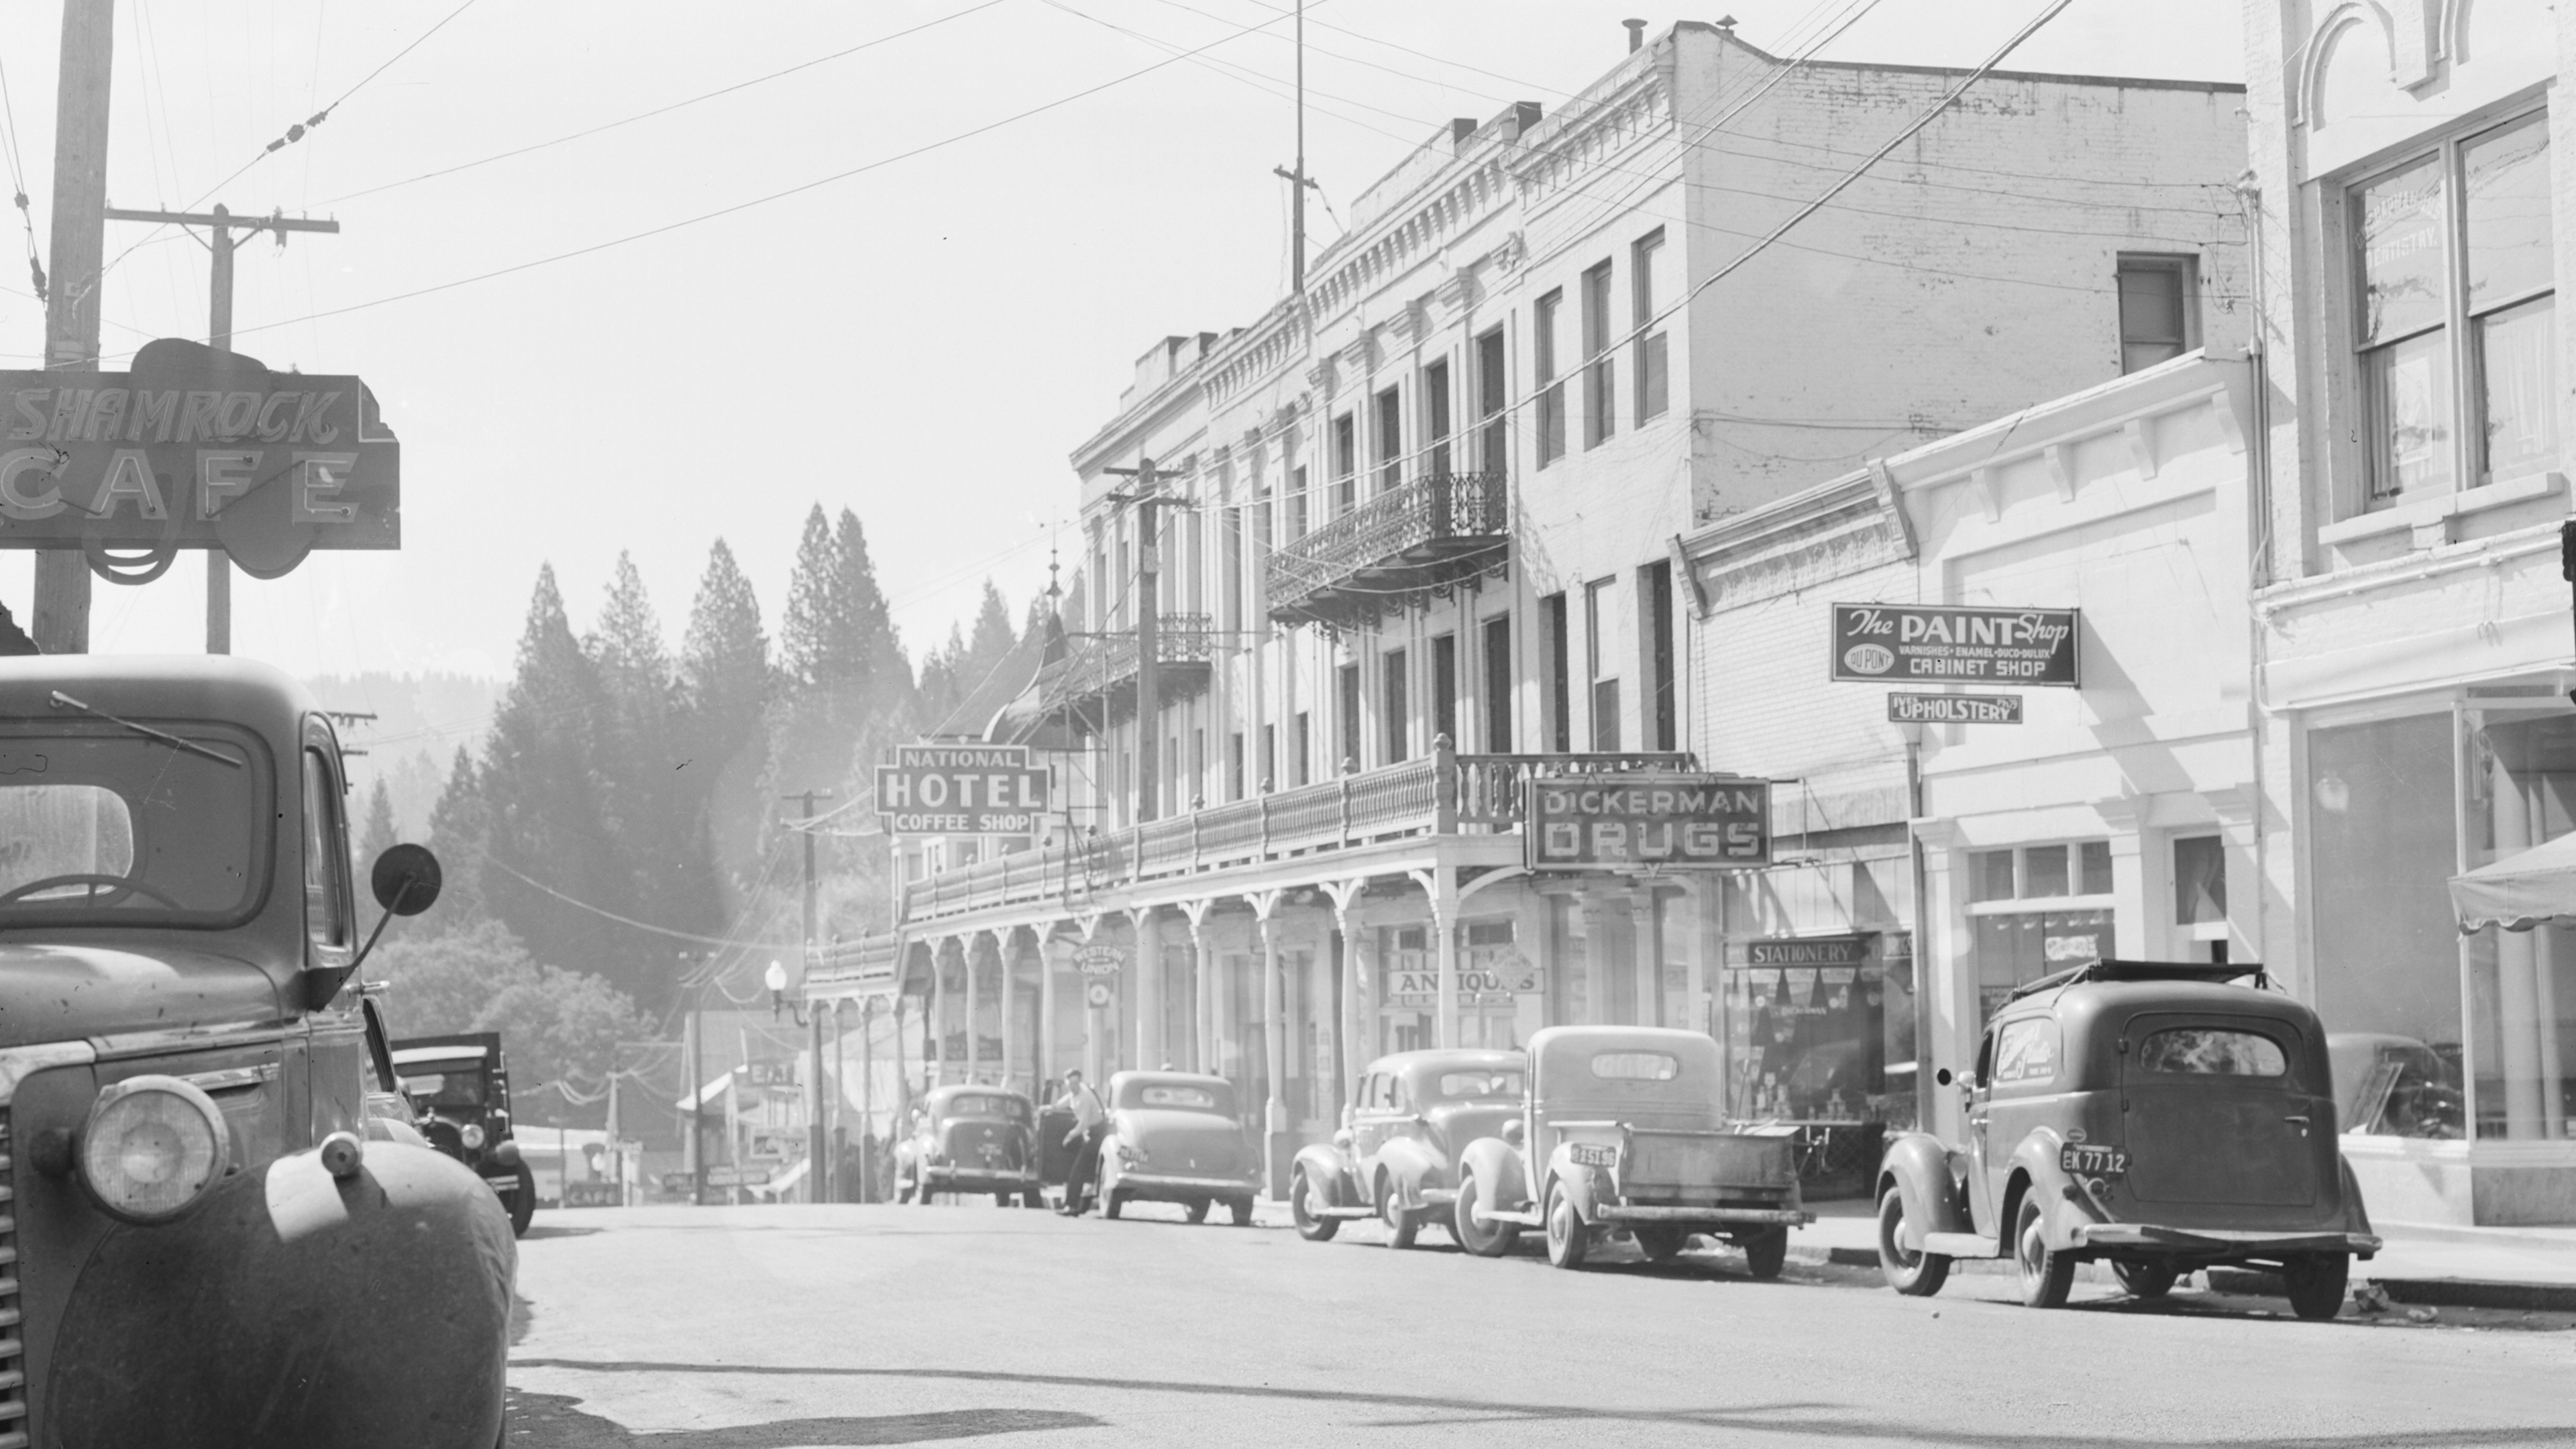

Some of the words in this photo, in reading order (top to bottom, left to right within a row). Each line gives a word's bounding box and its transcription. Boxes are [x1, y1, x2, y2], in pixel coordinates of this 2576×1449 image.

[8, 388, 343, 444] SHAMROCK
[0, 448, 360, 523] CAFE
[1847, 609, 1894, 637] The
[1900, 614, 2019, 645] PAINT
[2015, 613, 2069, 655] Shop
[1899, 645, 1949, 657] VARNISHES
[1911, 658, 1988, 676] CABINET
[1996, 660, 2045, 677] SHOP
[1899, 699, 2011, 721] UPHOLSTERY
[905, 751, 1021, 767] NATIONAL
[885, 773, 1041, 808] HOTEL
[1544, 790, 1759, 814] DICKERMAN
[896, 814, 969, 830] COFFEE
[979, 814, 1029, 831] SHOP
[1545, 822, 1759, 857] DRUGS
[1073, 945, 1126, 963] WESTERN
[1754, 943, 1854, 963] STATIONERY
[1081, 961, 1120, 975] UNION
[1400, 973, 1535, 991] ANIQUS
